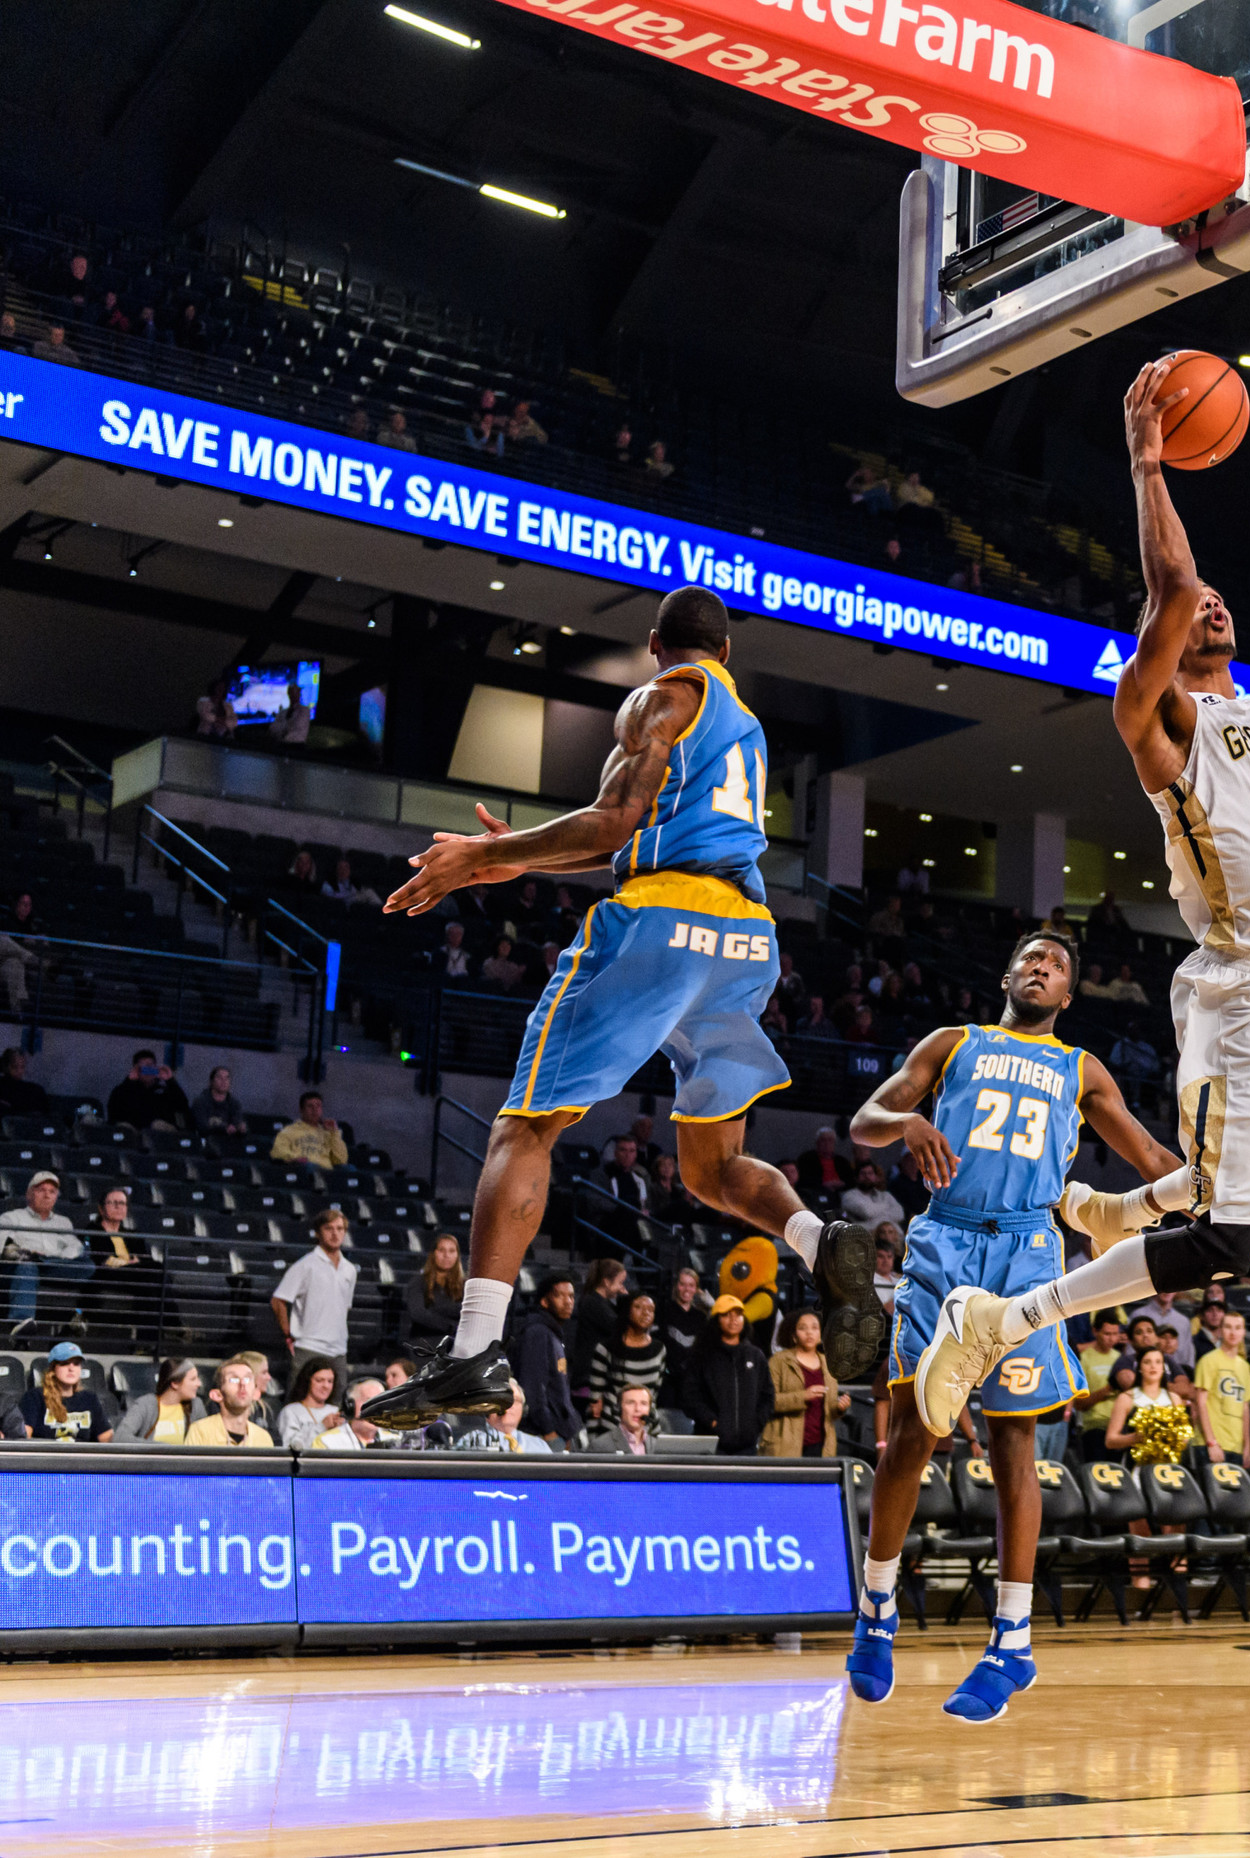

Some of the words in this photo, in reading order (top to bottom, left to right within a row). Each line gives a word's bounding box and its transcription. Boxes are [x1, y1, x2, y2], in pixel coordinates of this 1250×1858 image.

[100, 401, 219, 467] SAVE
[230, 431, 394, 510] MONEY.
[405, 476, 508, 537] SAVE
[518, 502, 672, 576] ENERGY.
[680, 541, 756, 596] Visit
[762, 573, 1048, 665] georgiapower.com
[668, 922, 770, 962] JAGS
[856, 1057, 878, 1073] 109
[971, 1053, 1065, 1101] SOUTHERN
[967, 1088, 1050, 1160] 23
[998, 1357, 1045, 1396] SU
[1219, 1376, 1247, 1402] GT
[1, 1518, 312, 1590] counting.
[331, 1520, 535, 1589] Payroll.
[552, 1522, 815, 1586] Payments.
